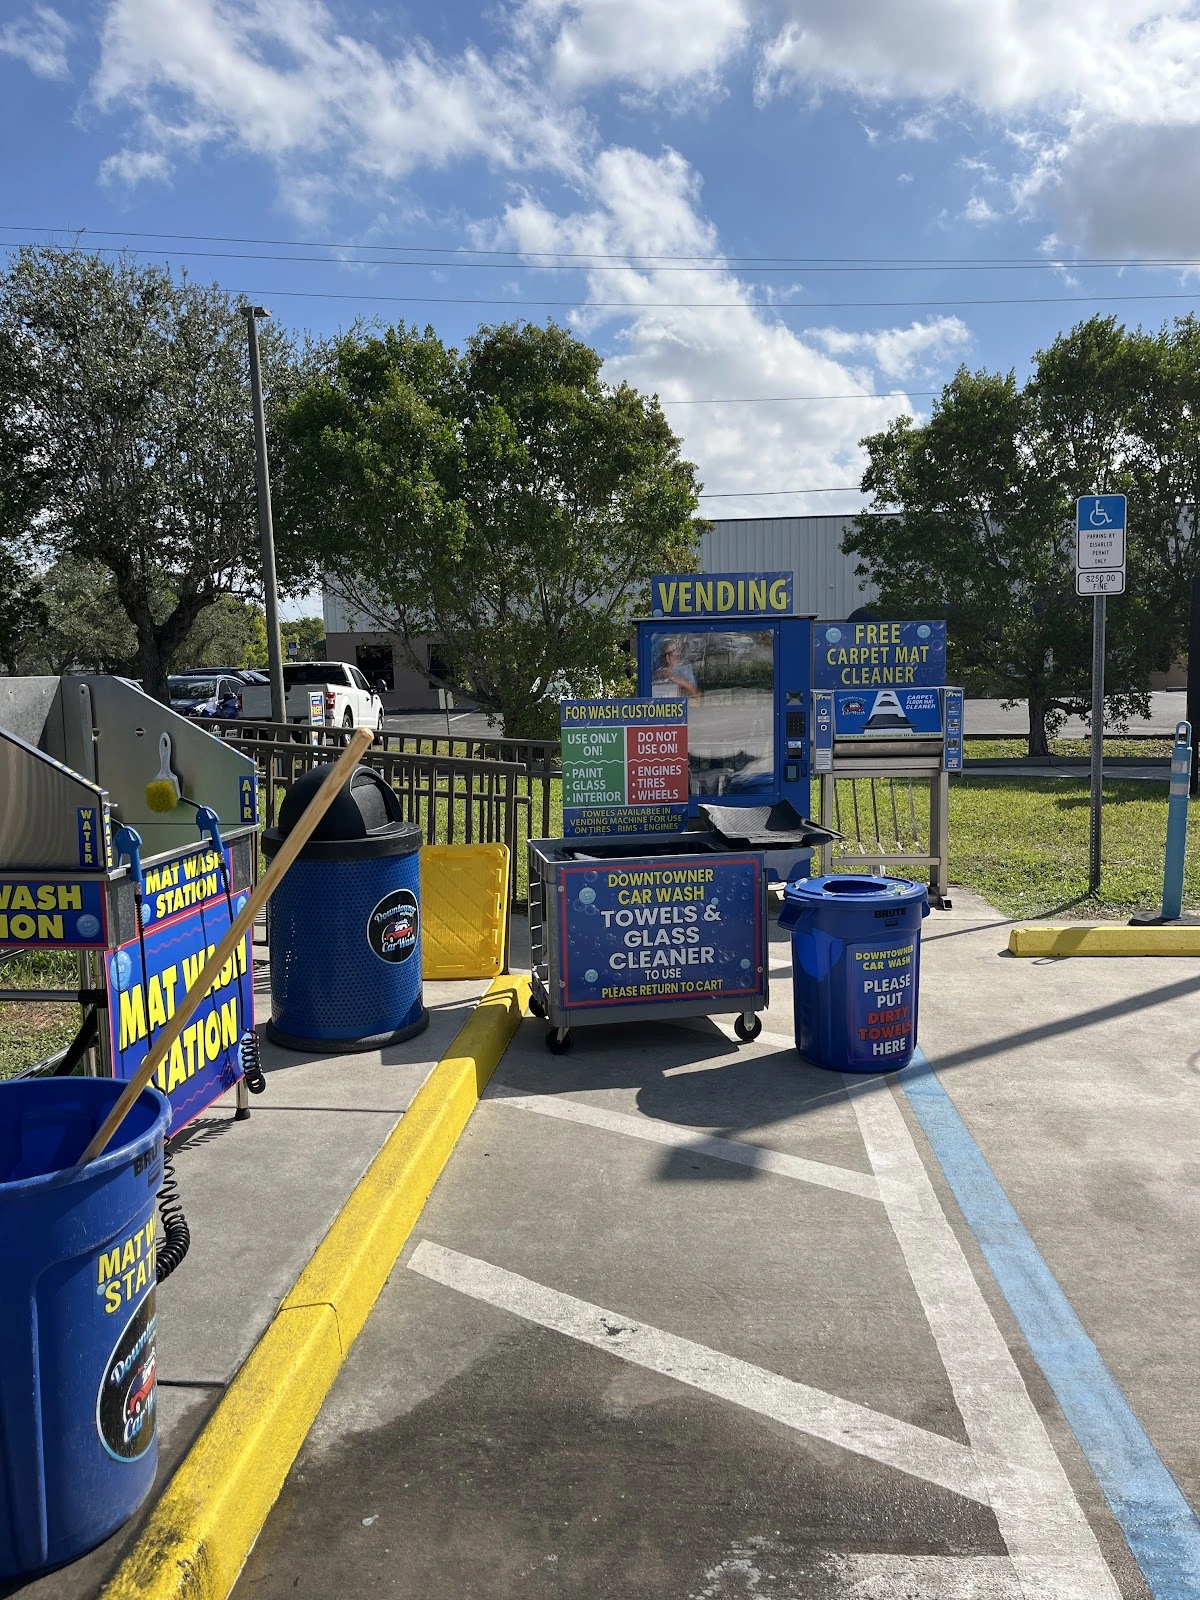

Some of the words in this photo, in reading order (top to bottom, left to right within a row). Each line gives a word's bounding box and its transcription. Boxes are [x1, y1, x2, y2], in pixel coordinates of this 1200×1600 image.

[658, 579, 788, 613] VENDING
[1093, 583, 1108, 591] FINE
[855, 624, 901, 645] FREE
[826, 647, 890, 666] CARPET
[895, 646, 930, 664] MAT
[841, 666, 915, 686] CLEANER
[565, 706, 587, 720] FOR
[588, 705, 619, 719] WASH
[622, 704, 684, 719] CUSTOMERS
[567, 734, 588, 744] USE
[590, 733, 618, 744] ONLY
[638, 732, 654, 742] DO
[656, 731, 678, 742] NOT
[583, 746, 603, 756] ON!
[638, 744, 658, 754] USE
[660, 743, 678, 754] ON!
[572, 768, 604, 778] PAINT
[637, 765, 682, 776] ENGINES
[572, 780, 606, 791] GLASS
[637, 778, 666, 788] TIRES
[242, 780, 252, 819] AIR
[572, 791, 622, 803] INTERIOR
[637, 789, 679, 800] WHEELS
[570, 818, 608, 826] VENDING
[610, 816, 648, 825] MACHINE
[650, 816, 666, 824] FOR
[667, 814, 682, 822] USE
[582, 809, 615, 818] TOWELS
[617, 808, 661, 816] AVAILABLE
[80, 809, 93, 864] WATER
[574, 826, 588, 834] ON
[588, 825, 611, 833] TIRES
[618, 824, 637, 832] RIMS
[644, 822, 678, 831] ENGINES
[104, 814, 113, 868] WATER
[146, 865, 180, 896] MAT
[608, 868, 714, 888] DOWNTOWNER
[156, 873, 218, 919] STATION
[618, 889, 652, 905] CAR
[656, 886, 705, 902] WASH
[600, 905, 698, 928] TOWELS
[703, 904, 722, 922] &
[874, 907, 906, 918] BRUTE
[382, 941, 398, 952] Car
[624, 926, 700, 948] GLASS
[609, 946, 715, 970] CLEANER
[855, 944, 914, 961] DOWNTOWNER
[862, 961, 885, 971] CAR
[888, 956, 911, 969] WASH
[644, 970, 660, 981] TO
[662, 968, 682, 979] USE
[863, 973, 912, 994] PLEASE
[602, 986, 638, 999] PLEASE
[640, 982, 679, 996] RETURN
[680, 981, 694, 992] TO
[696, 979, 724, 992] CART
[118, 964, 178, 1053] MAT
[877, 992, 904, 1008] PUT
[867, 1005, 909, 1026] DIRTY
[858, 1019, 913, 1041] TOWELS
[141, 996, 238, 1094] TATION
[872, 1037, 906, 1056] HERE
[134, 1142, 158, 1178] BRU
[98, 1228, 145, 1284] MAT
[124, 1411, 146, 1443] Car
